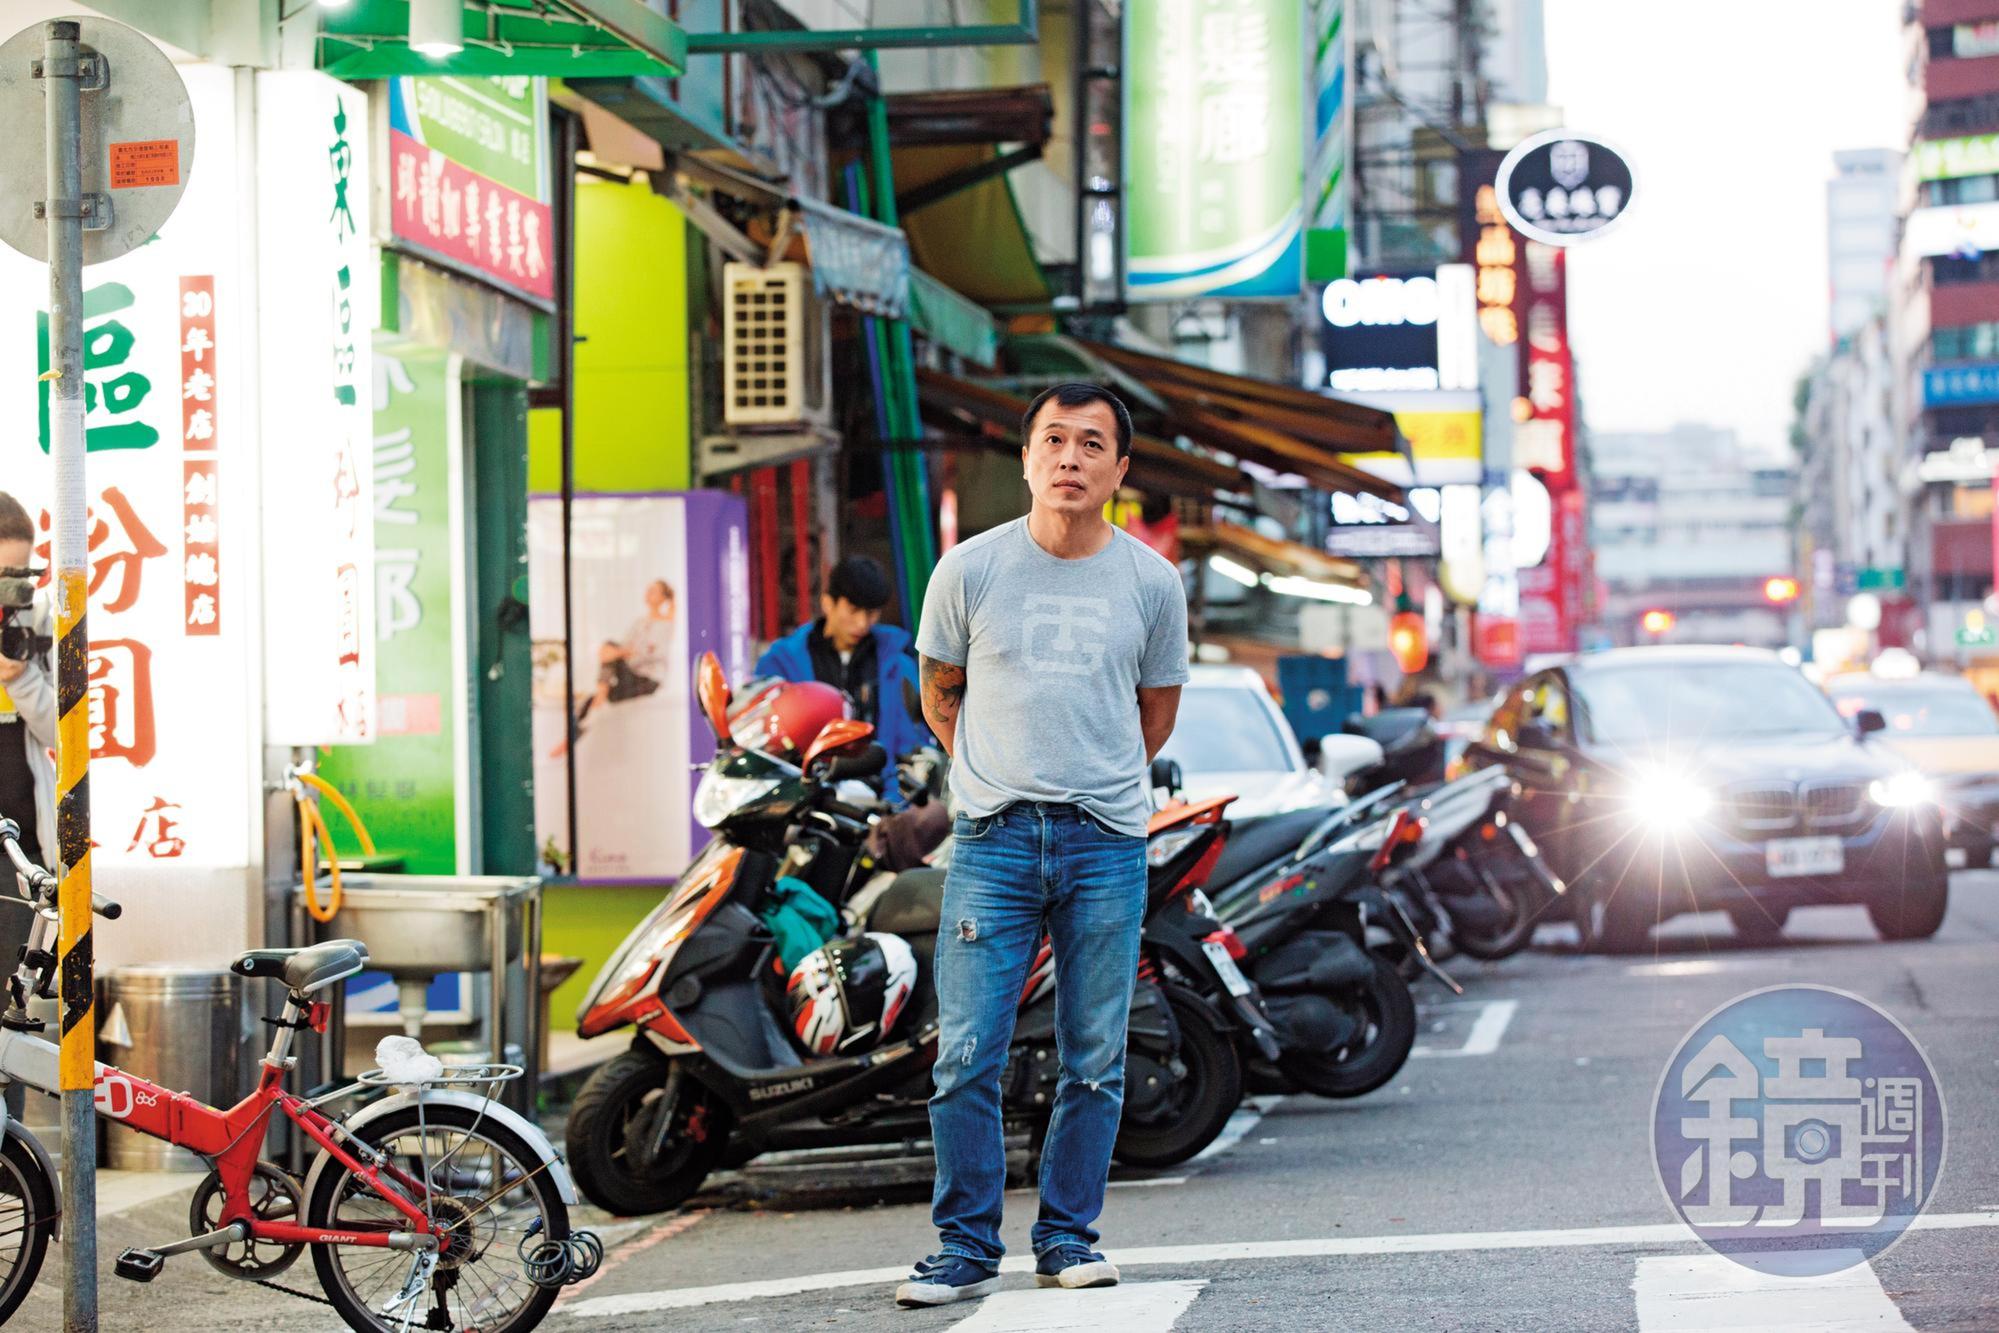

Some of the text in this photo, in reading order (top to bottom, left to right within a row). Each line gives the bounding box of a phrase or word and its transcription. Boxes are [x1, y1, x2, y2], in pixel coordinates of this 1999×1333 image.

[181, 289, 215, 441] 30年老店
[35, 232, 168, 768] 區粉圓
[749, 1077, 813, 1100] SUZUKI
[319, 1234, 358, 1243] GIANT
